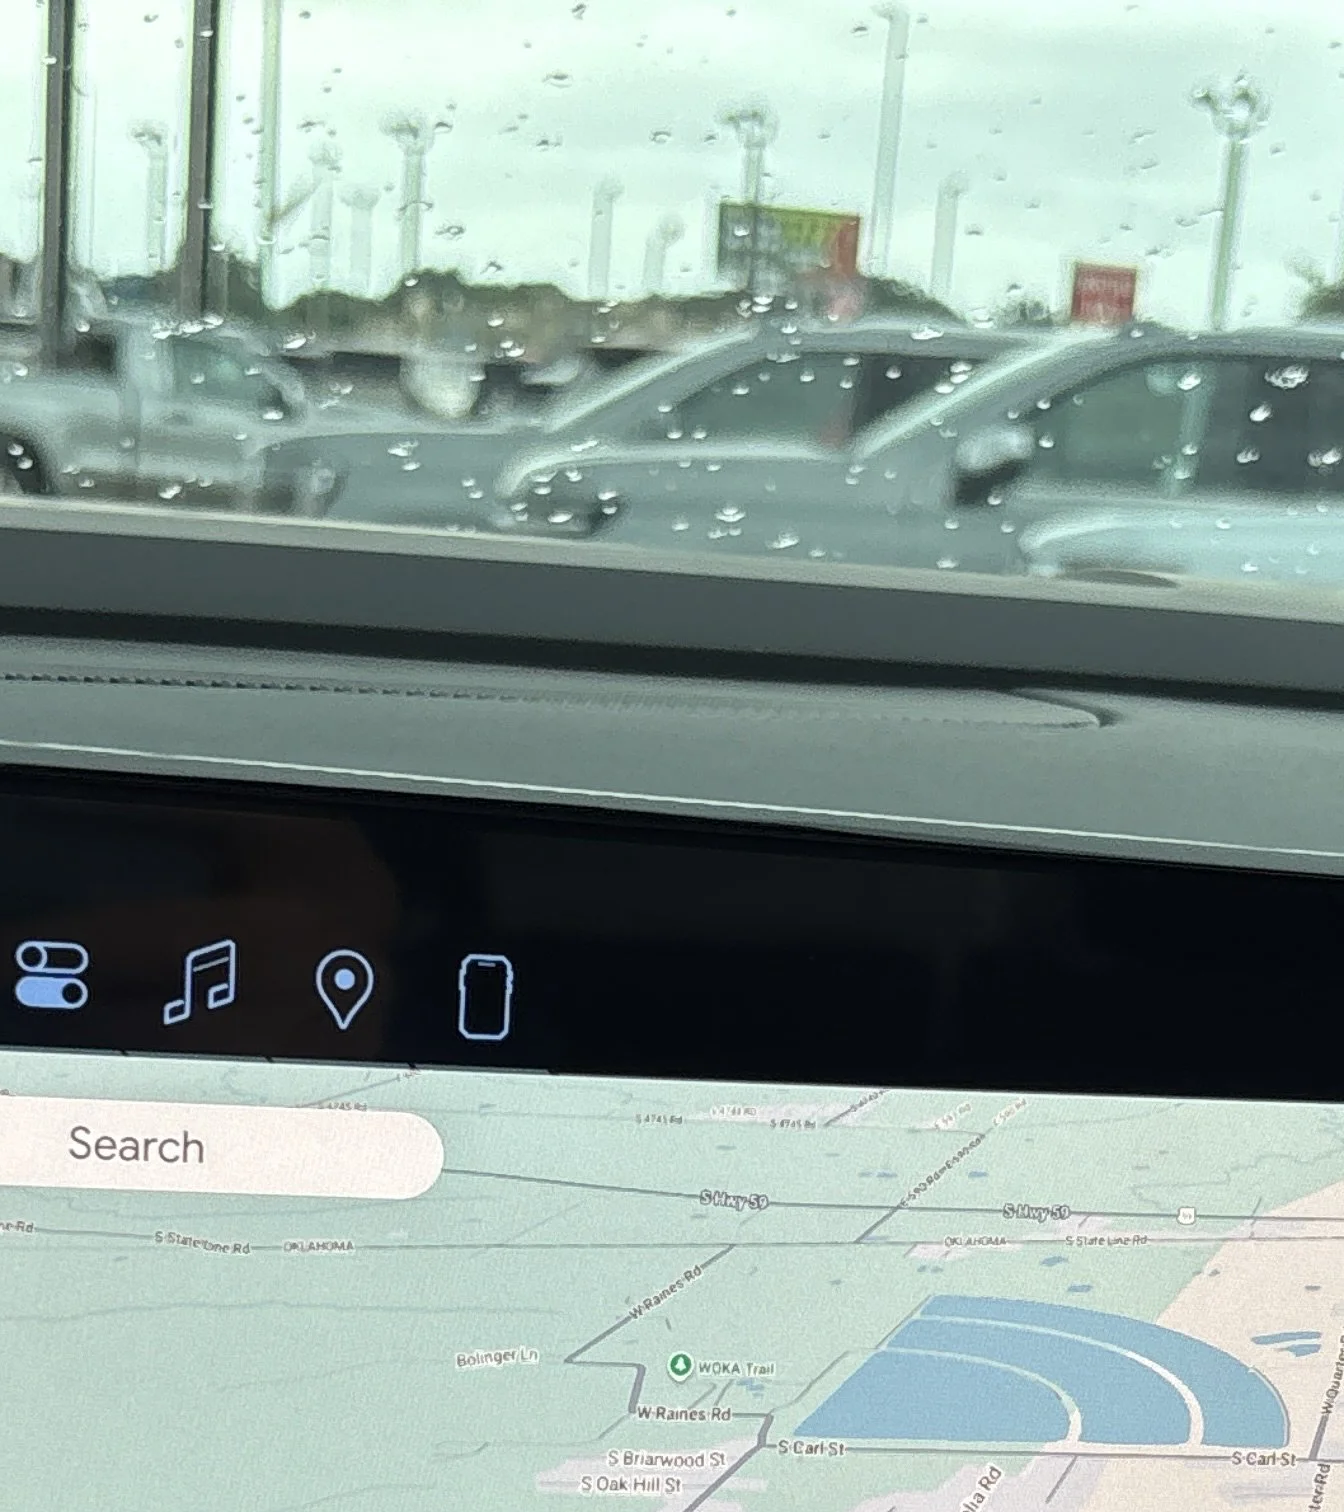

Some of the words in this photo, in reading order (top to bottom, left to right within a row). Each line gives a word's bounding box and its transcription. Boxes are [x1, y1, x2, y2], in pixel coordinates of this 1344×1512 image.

[69, 1125, 205, 1164] Search
[456, 1350, 516, 1368] Bolinger
[519, 1349, 538, 1361] Ln
[699, 1362, 740, 1375] WOKA
[746, 1362, 774, 1375] Trail
[608, 1450, 619, 1465] S
[623, 1450, 705, 1467] Briarwood
[709, 1451, 726, 1468] St
[581, 1476, 592, 1491] S
[596, 1476, 629, 1492] Oak
[633, 1476, 660, 1492] Hill
[664, 1476, 682, 1493] St
[979, 1465, 1002, 1490] Rd
